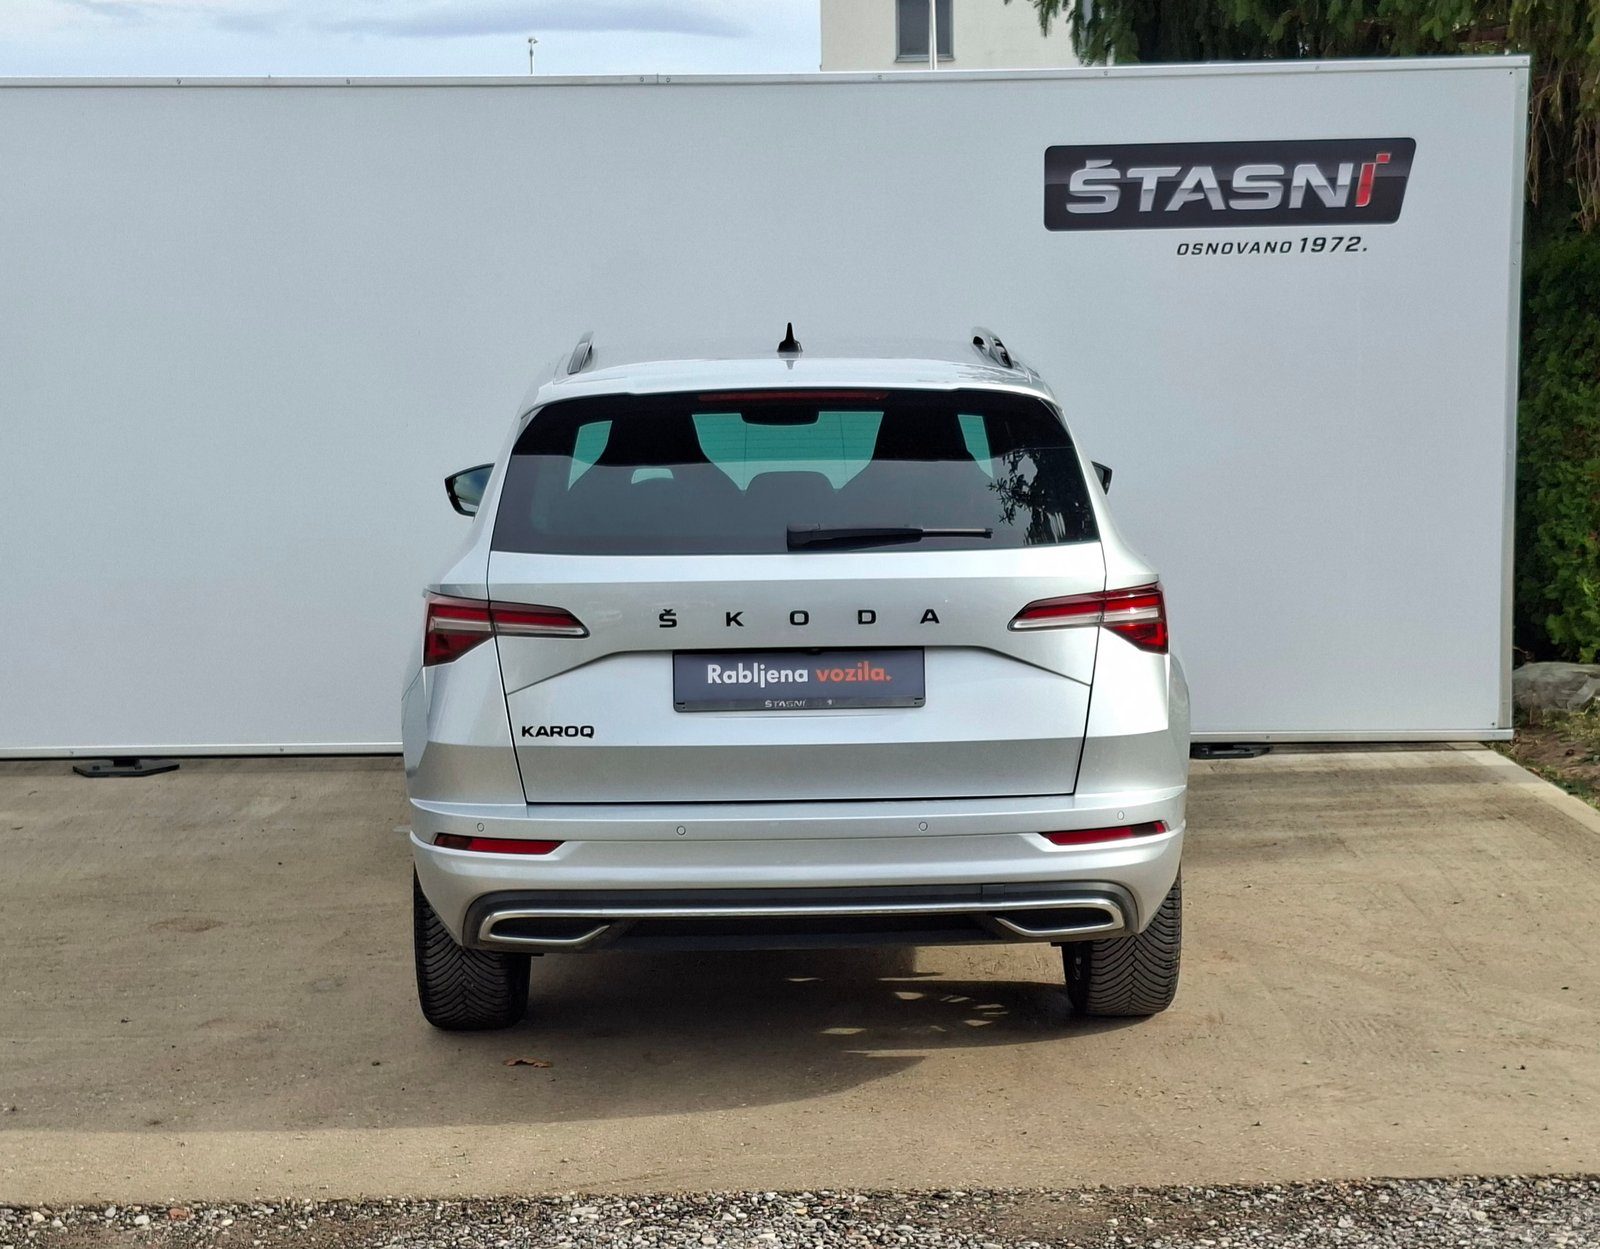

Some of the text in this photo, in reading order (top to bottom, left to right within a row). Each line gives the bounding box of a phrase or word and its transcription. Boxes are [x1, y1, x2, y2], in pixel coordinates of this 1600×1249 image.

[1176, 235, 1368, 256] OSNOVANO 1972.
[658, 608, 940, 628] ŠKODA
[707, 661, 893, 688] Rabljena vozila.
[521, 725, 595, 739] KAROQ
